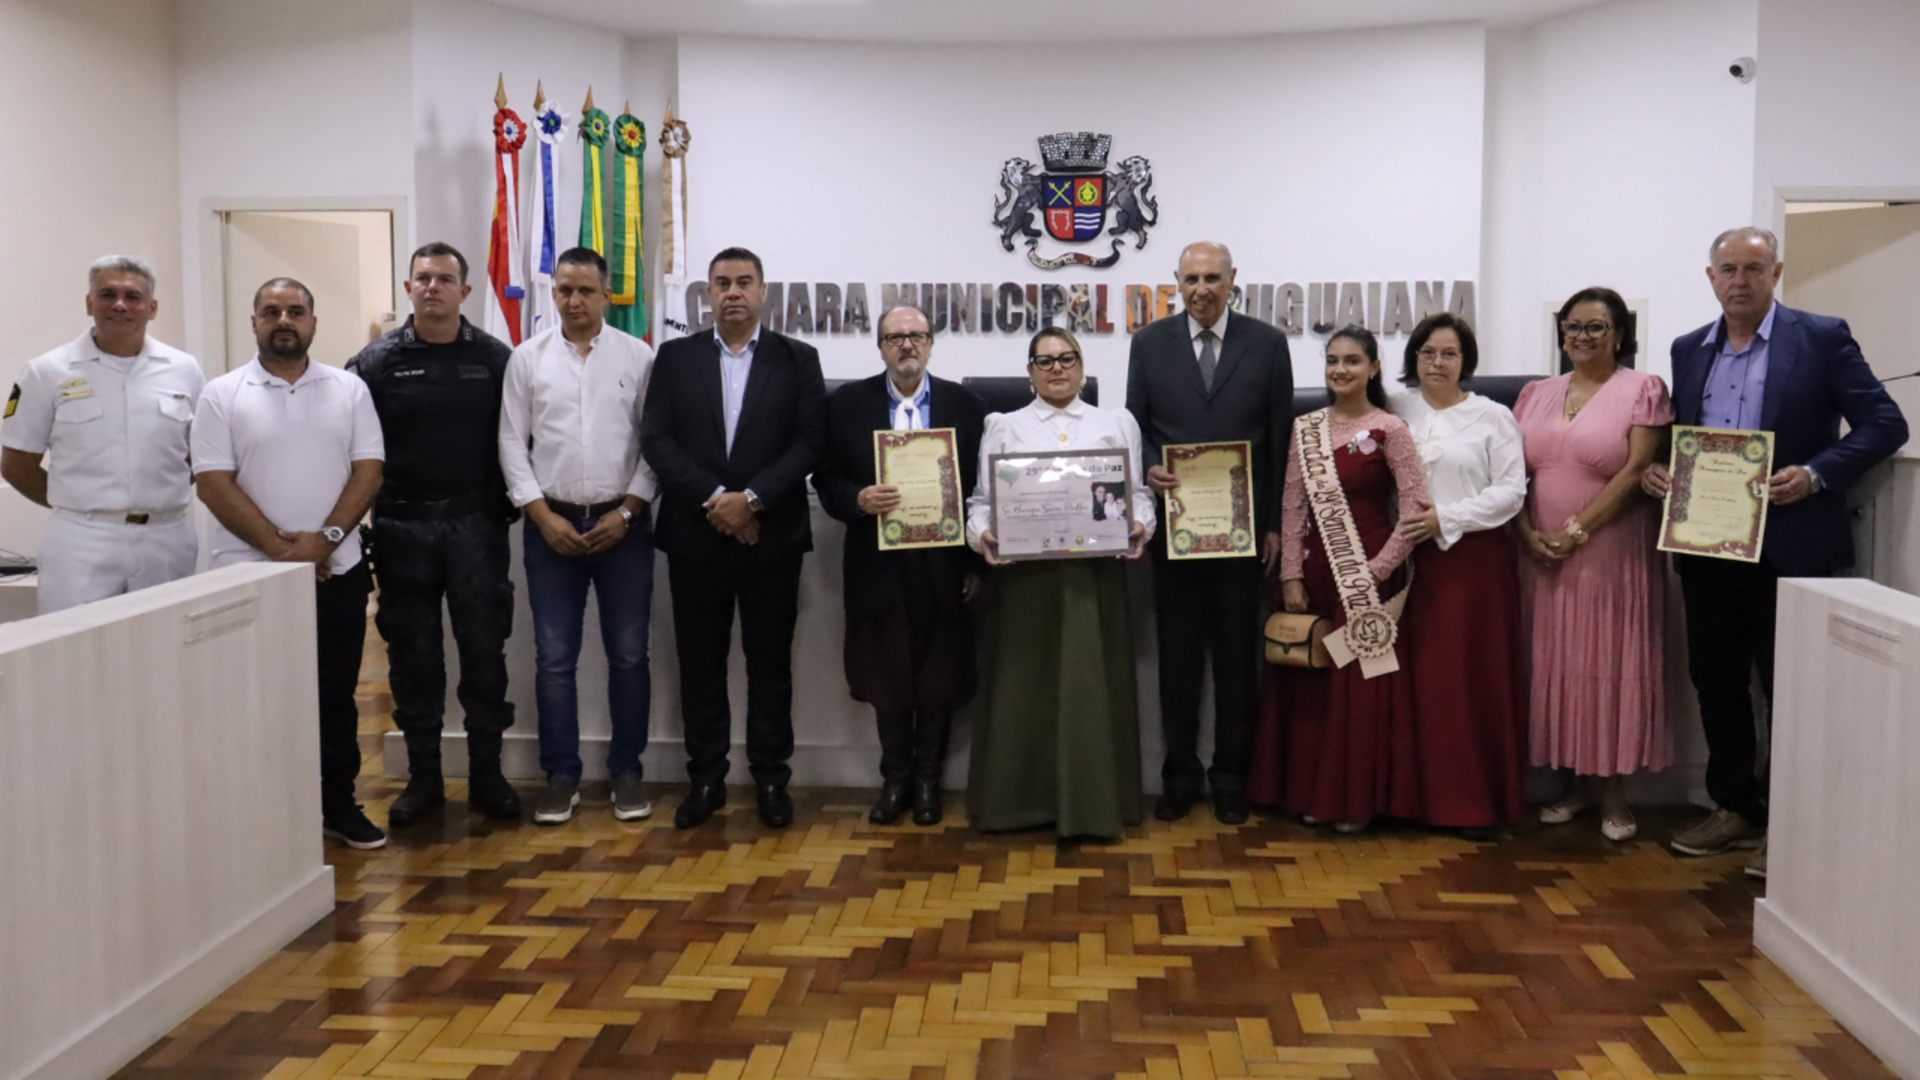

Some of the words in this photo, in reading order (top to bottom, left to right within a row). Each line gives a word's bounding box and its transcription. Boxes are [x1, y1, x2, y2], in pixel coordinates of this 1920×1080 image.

[685, 281, 871, 334] CMARA
[1126, 284, 1177, 334] DE
[1104, 464, 1123, 472] Paz
[1319, 506, 1356, 560] Semana
[1335, 559, 1365, 578] da
[1341, 577, 1372, 610] Paz
